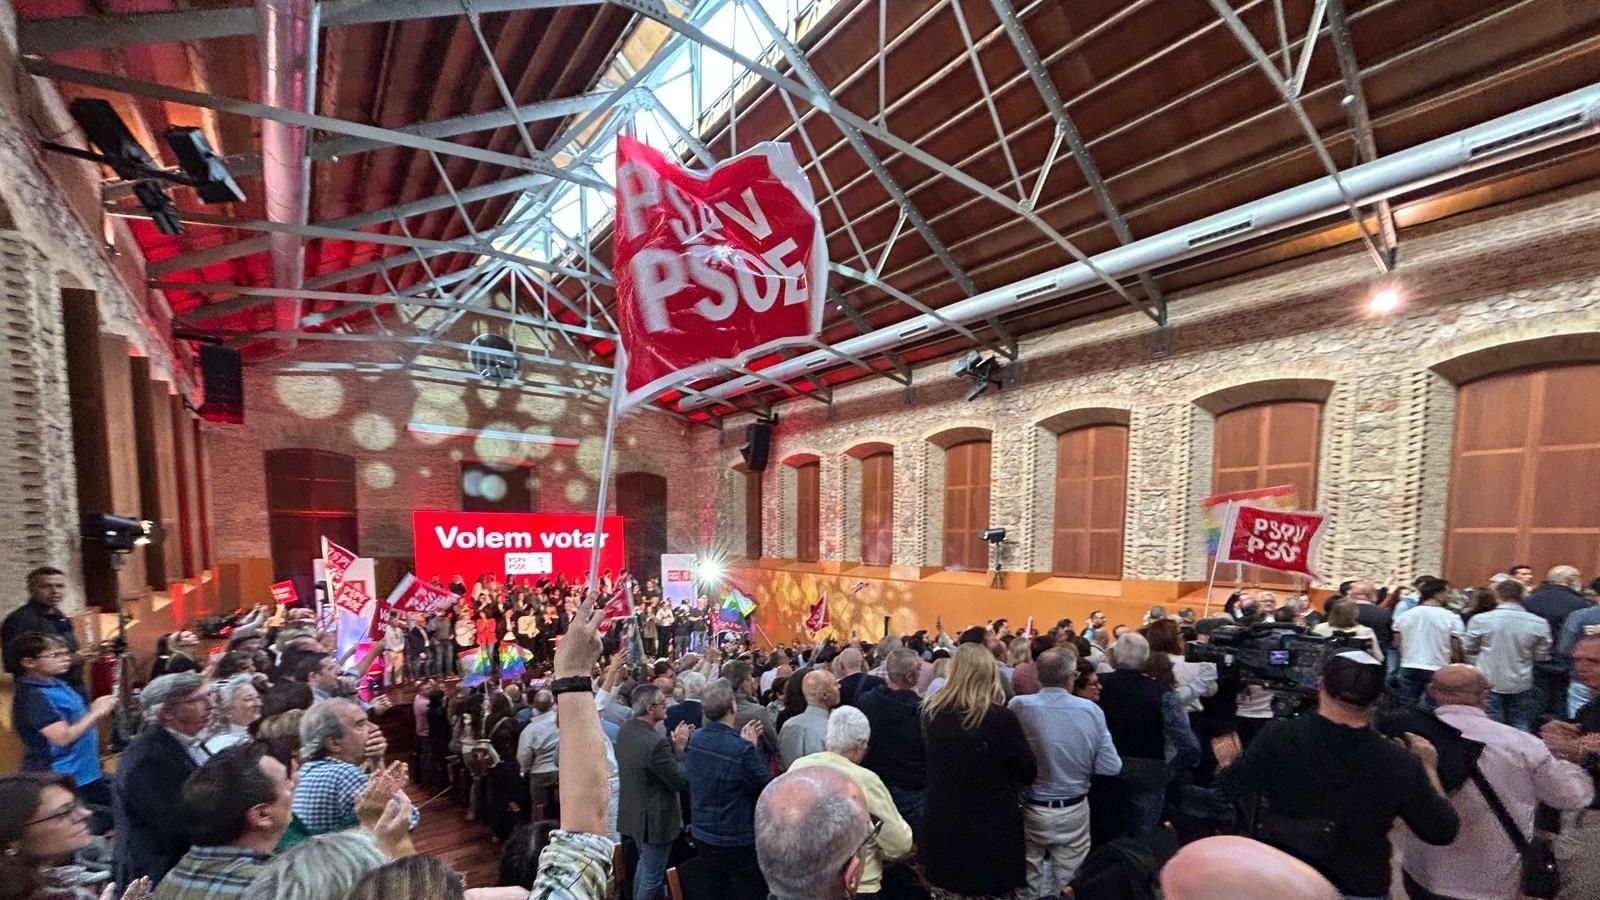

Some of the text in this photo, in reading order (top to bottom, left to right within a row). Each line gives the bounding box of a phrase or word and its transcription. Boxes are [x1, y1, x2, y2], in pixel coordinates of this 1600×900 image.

[630, 238, 809, 333] PSOE
[434, 525, 609, 549] Volem votar
